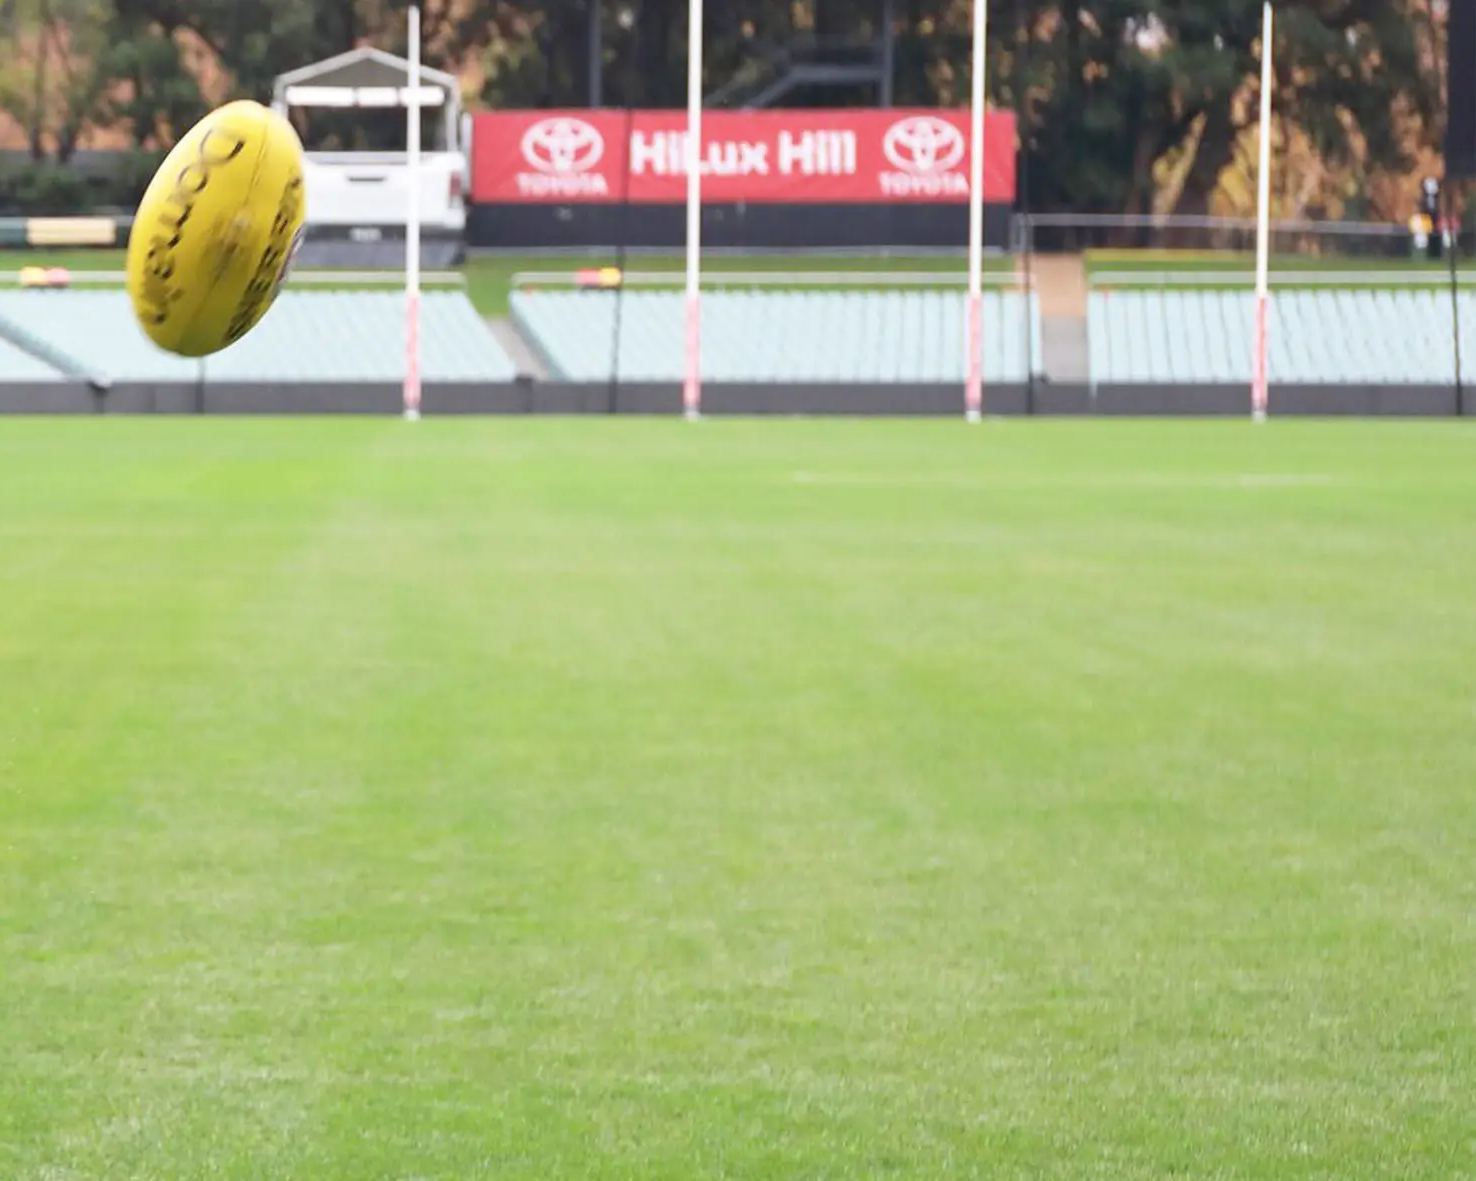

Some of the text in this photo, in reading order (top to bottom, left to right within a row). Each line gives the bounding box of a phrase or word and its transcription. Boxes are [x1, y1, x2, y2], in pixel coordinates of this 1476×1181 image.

[777, 129, 857, 176] Hill
[515, 172, 609, 196] TOYOTA
[878, 171, 970, 196] TOYOTA
